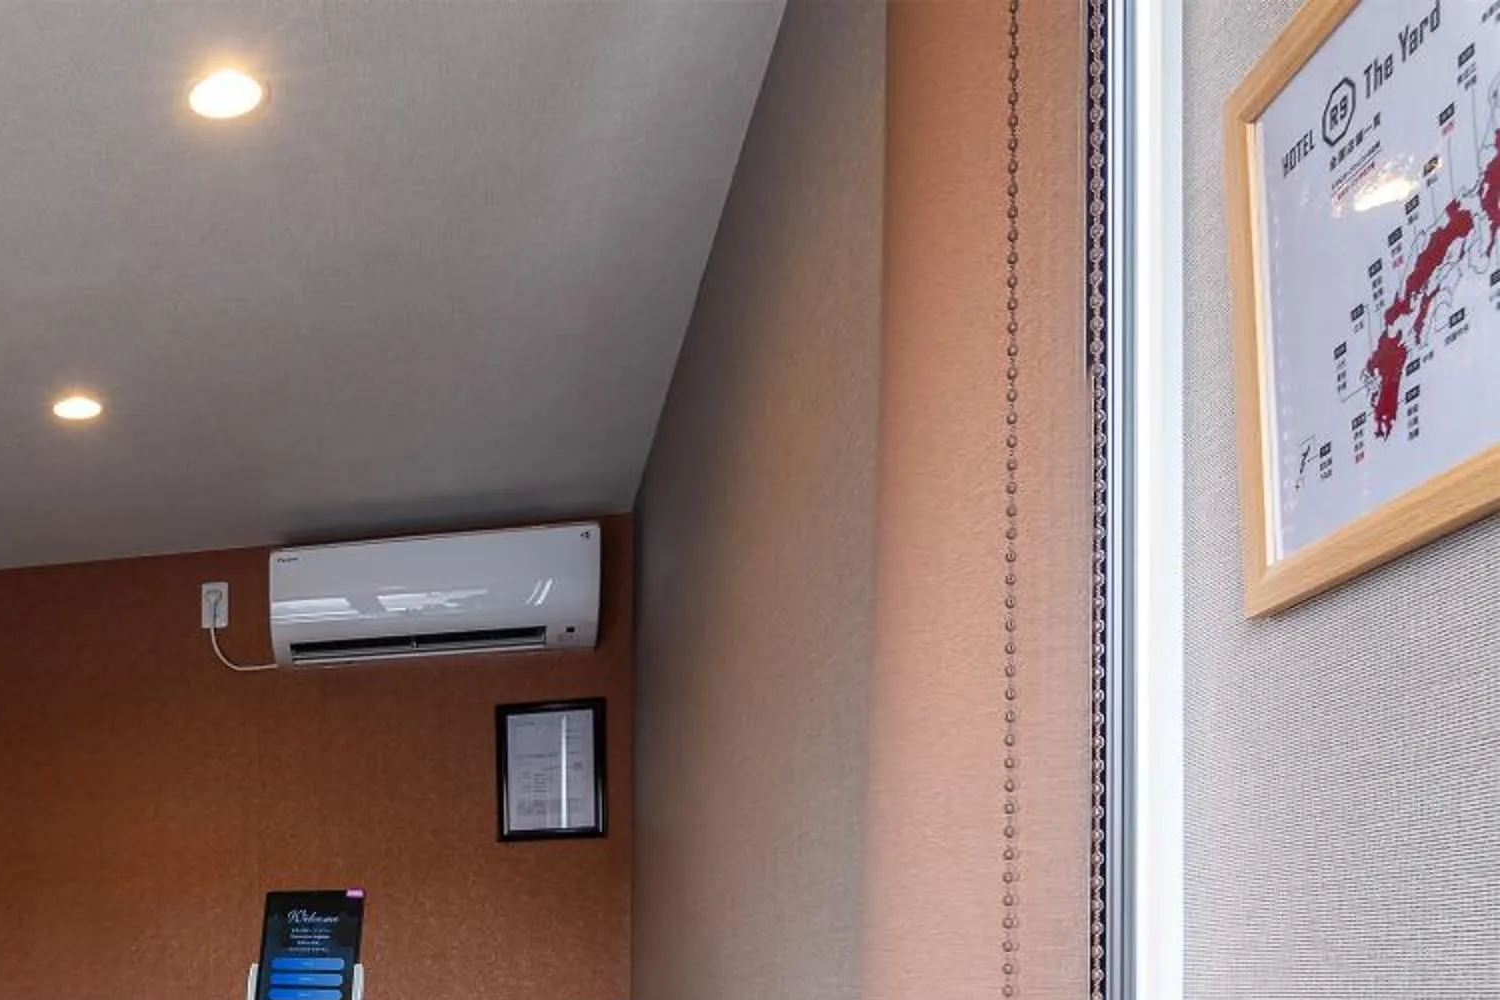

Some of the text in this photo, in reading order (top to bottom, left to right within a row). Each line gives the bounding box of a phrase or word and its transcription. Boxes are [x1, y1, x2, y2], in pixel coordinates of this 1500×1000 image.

[1282, 128, 1317, 178] HOTEL
[1363, 53, 1395, 100] The
[1398, 0, 1442, 63] Yard
